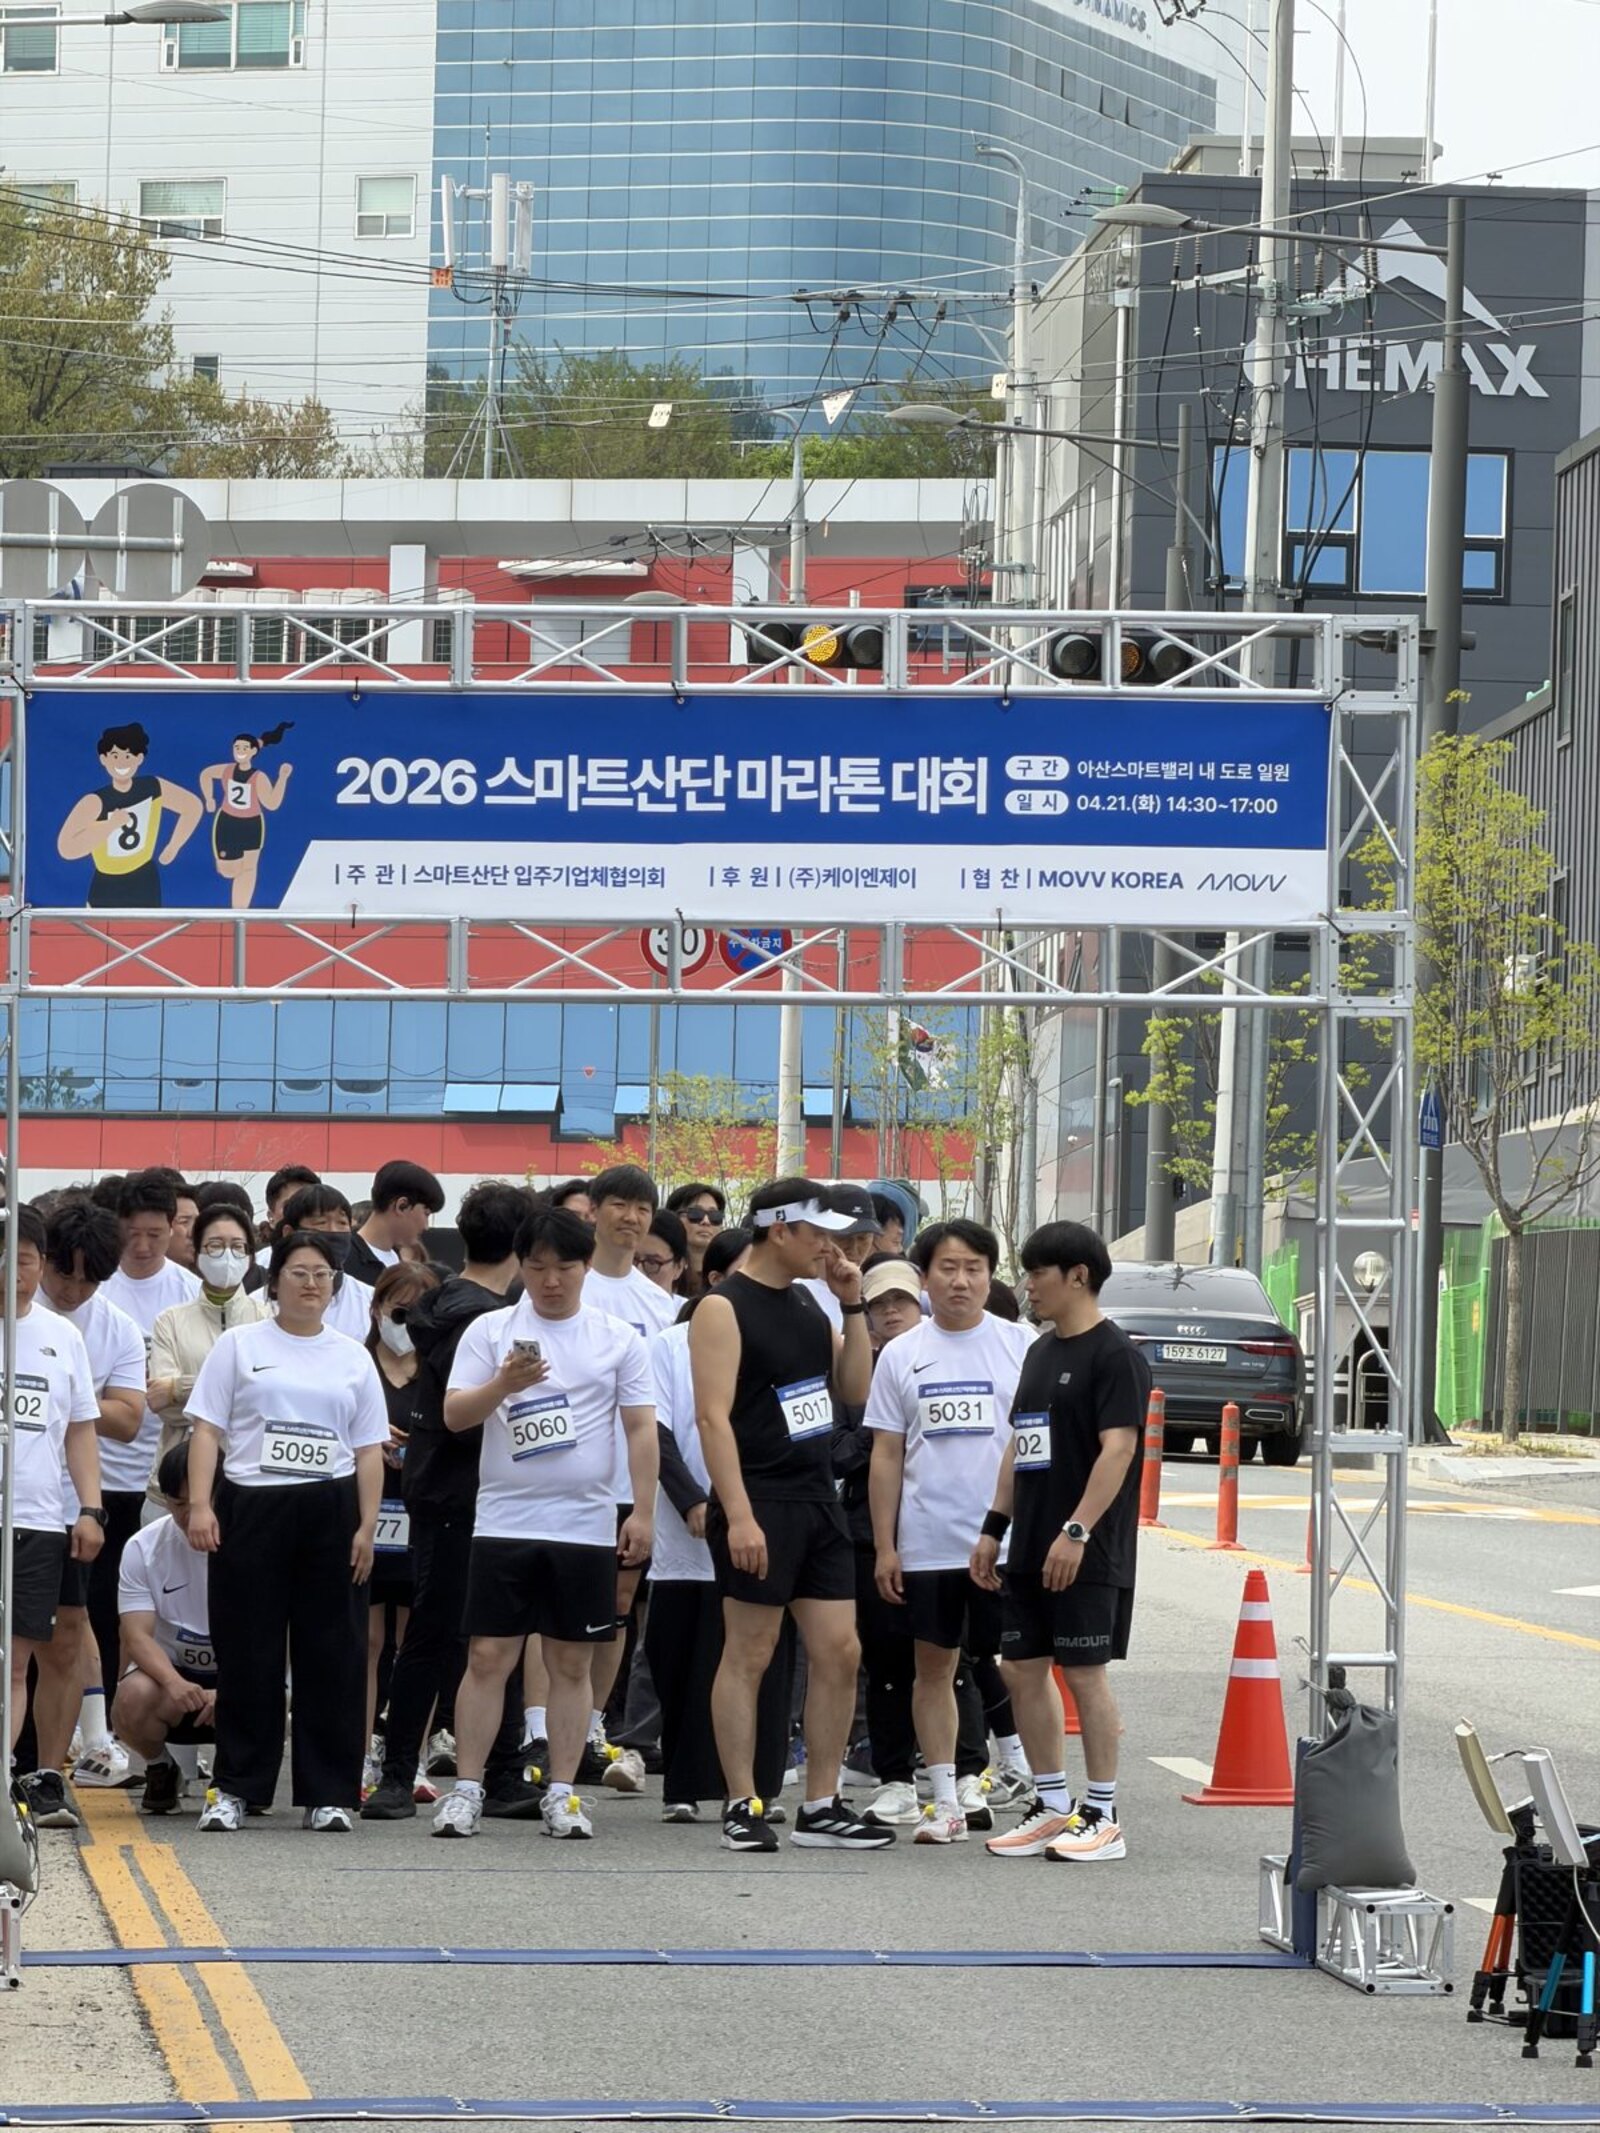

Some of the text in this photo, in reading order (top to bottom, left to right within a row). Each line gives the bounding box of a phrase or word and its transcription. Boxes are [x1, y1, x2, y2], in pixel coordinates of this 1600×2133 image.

[1077, 760, 1193, 781] 아산스마트밸리
[1199, 761, 1215, 781] 내
[1219, 763, 1253, 781] 도로
[1257, 762, 1290, 782] 일원
[231, 786, 247, 806] 2
[336, 754, 988, 815] 2026 스마트산단 마라톤 대회
[1076, 794, 1161, 815] 04.21.(화)
[1166, 796, 1278, 814] 14:30~17:00
[413, 864, 509, 887] 스마트산단
[514, 865, 665, 888] 입주기업체협의회
[788, 866, 917, 890] (주)케이엔제이
[1038, 870, 1106, 889] MOVV
[1111, 871, 1184, 890] KOREA
[1196, 1347, 1225, 1360] 6127
[792, 1396, 829, 1425] 5017
[928, 1400, 983, 1424] 5031
[513, 1415, 567, 1446] 5060
[271, 1440, 329, 1466] 5095
[1053, 1634, 1110, 1648] RMOUR
[184, 1648, 214, 1666] 50
